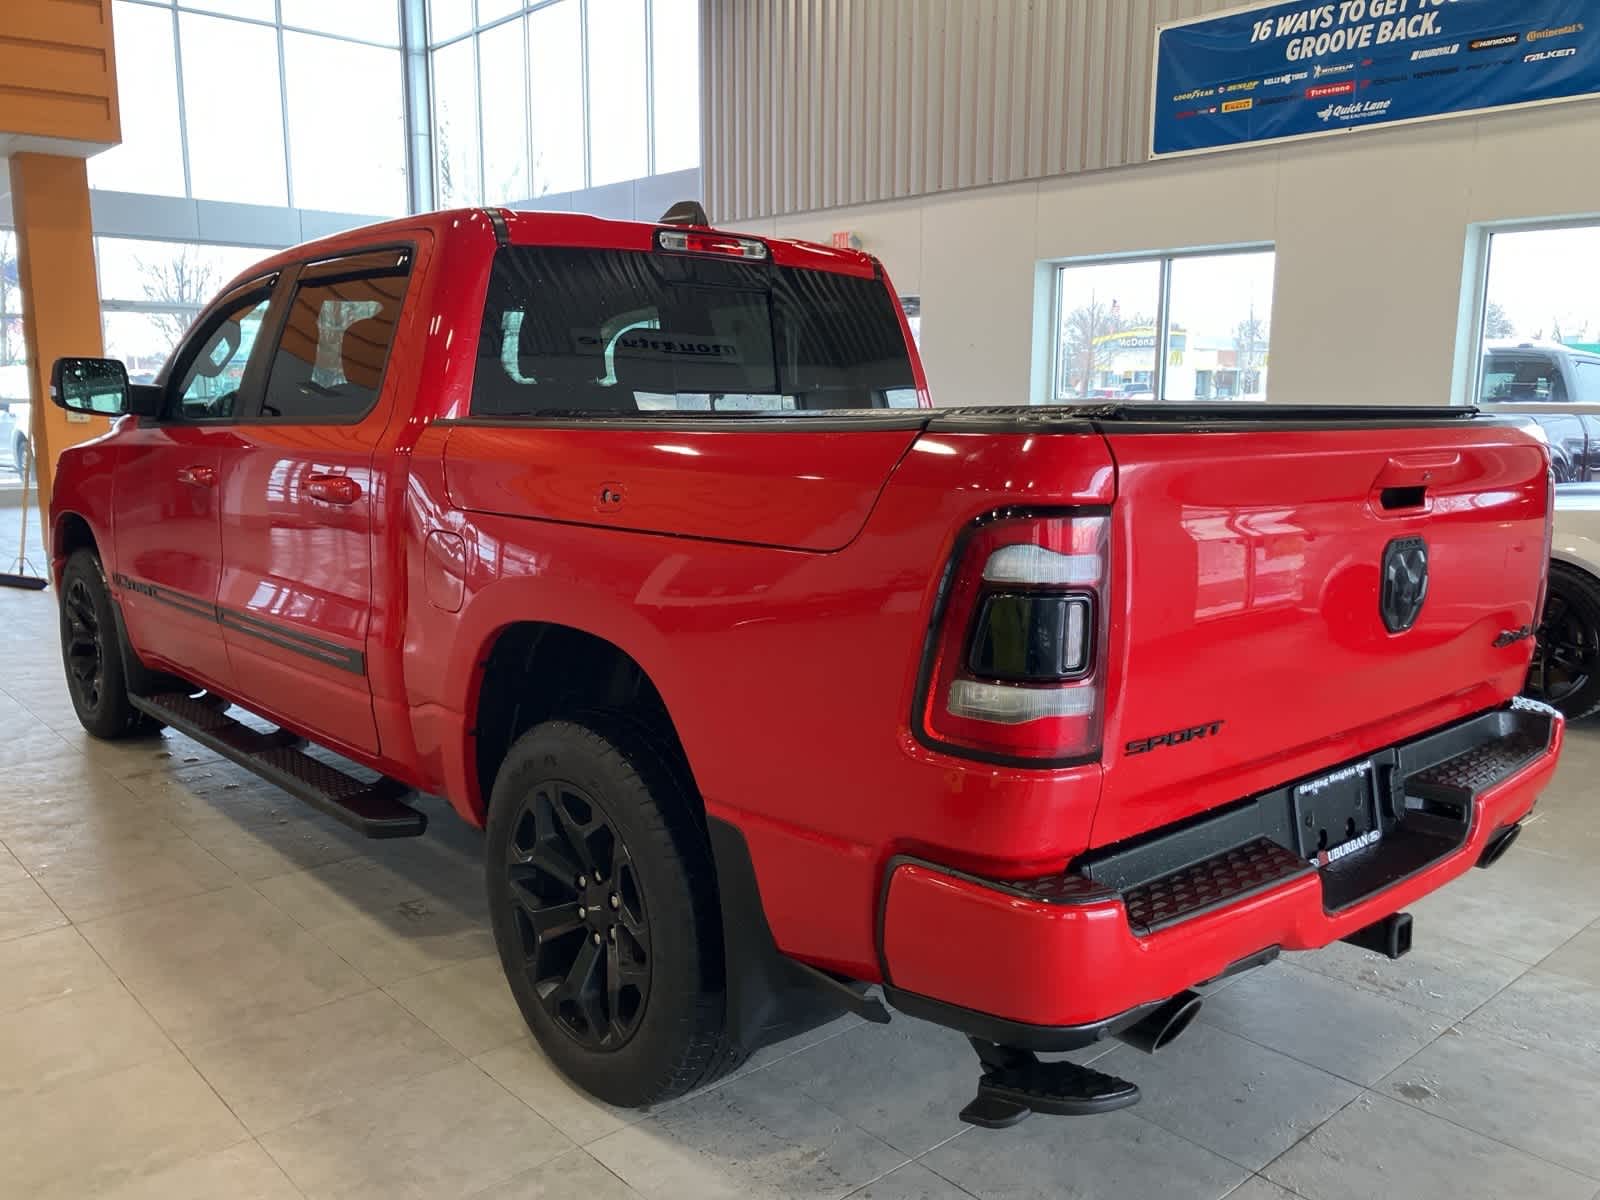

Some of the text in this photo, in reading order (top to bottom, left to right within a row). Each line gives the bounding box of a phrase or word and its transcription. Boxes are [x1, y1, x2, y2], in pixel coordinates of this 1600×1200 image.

[1251, 19, 1273, 43] 16
[1275, 5, 1334, 37] WAYS
[1338, 0, 1366, 25] TO
[1286, 11, 1442, 61] GROOVE BACK.
[1526, 25, 1576, 42] Continental
[1227, 81, 1259, 92] DUNLOP
[1310, 84, 1351, 97] Firestone
[1173, 89, 1214, 102] GOODYEAR
[1332, 99, 1391, 116] Quick Lane
[1124, 720, 1224, 756] SPORT
